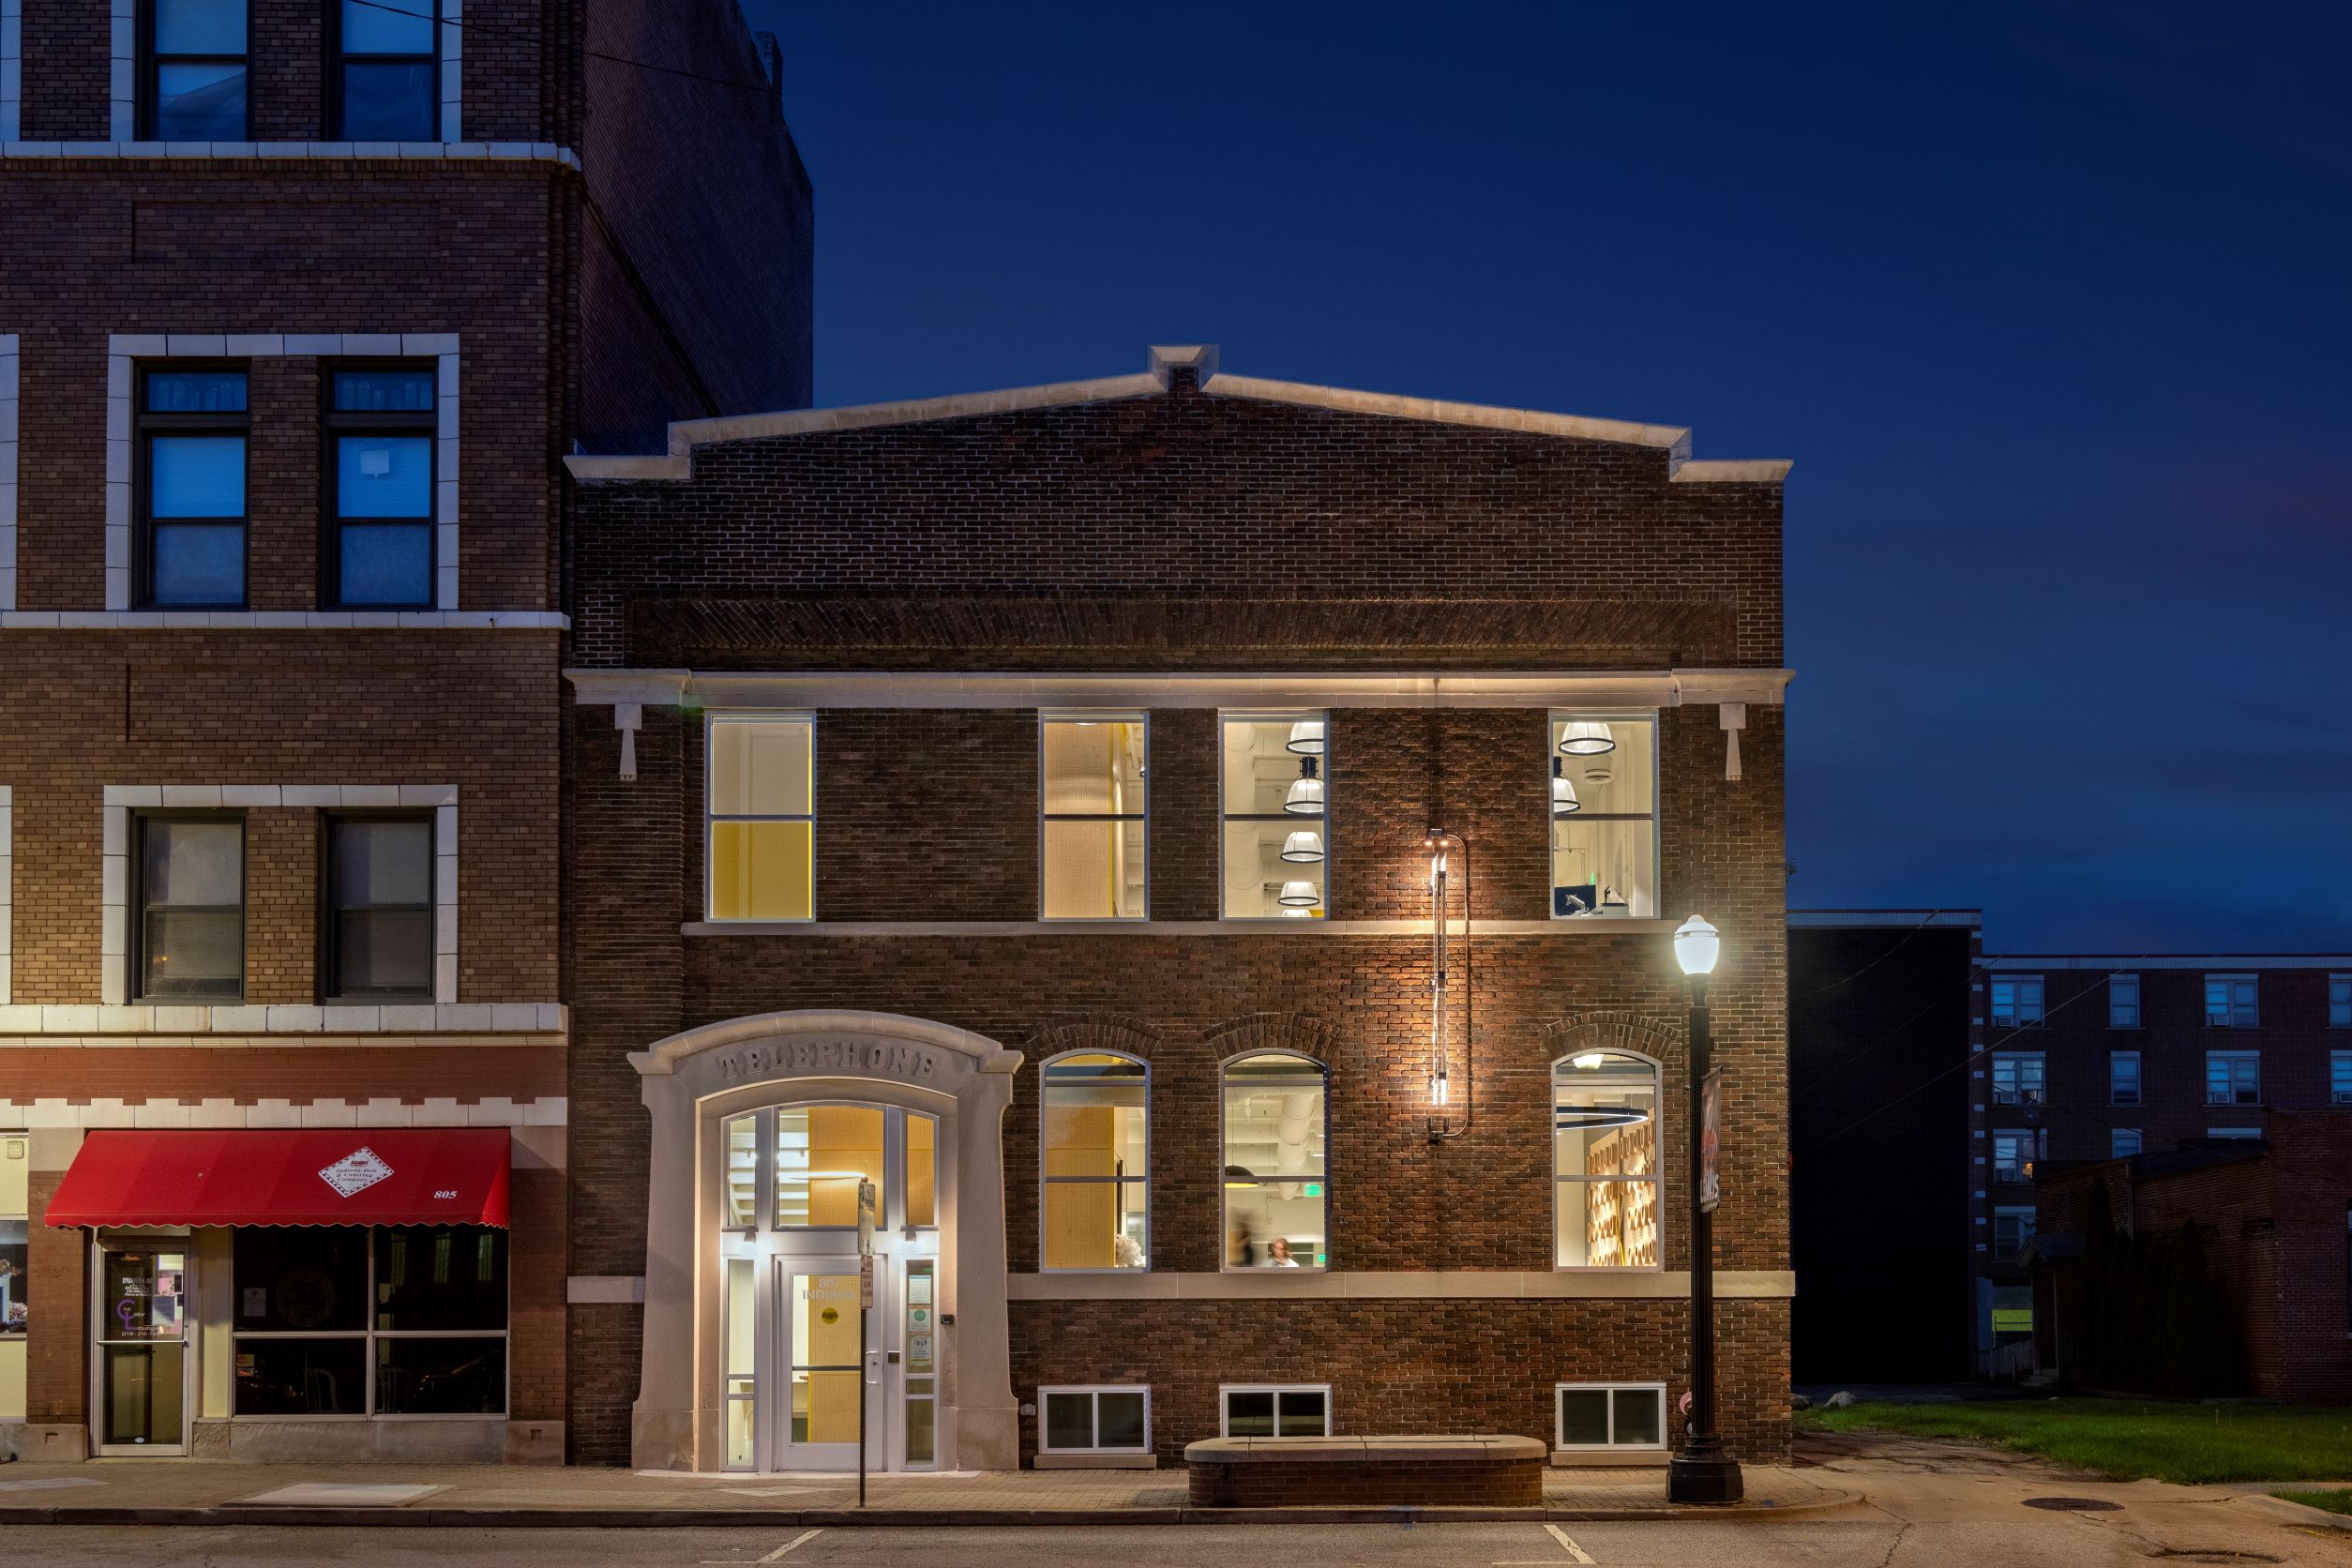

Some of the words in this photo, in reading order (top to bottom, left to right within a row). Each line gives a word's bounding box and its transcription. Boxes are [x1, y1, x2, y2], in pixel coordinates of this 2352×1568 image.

[717, 1042, 937, 1078] TELEPHONE
[433, 1190, 458, 1199] 805
[803, 1289, 856, 1301] INDIA
